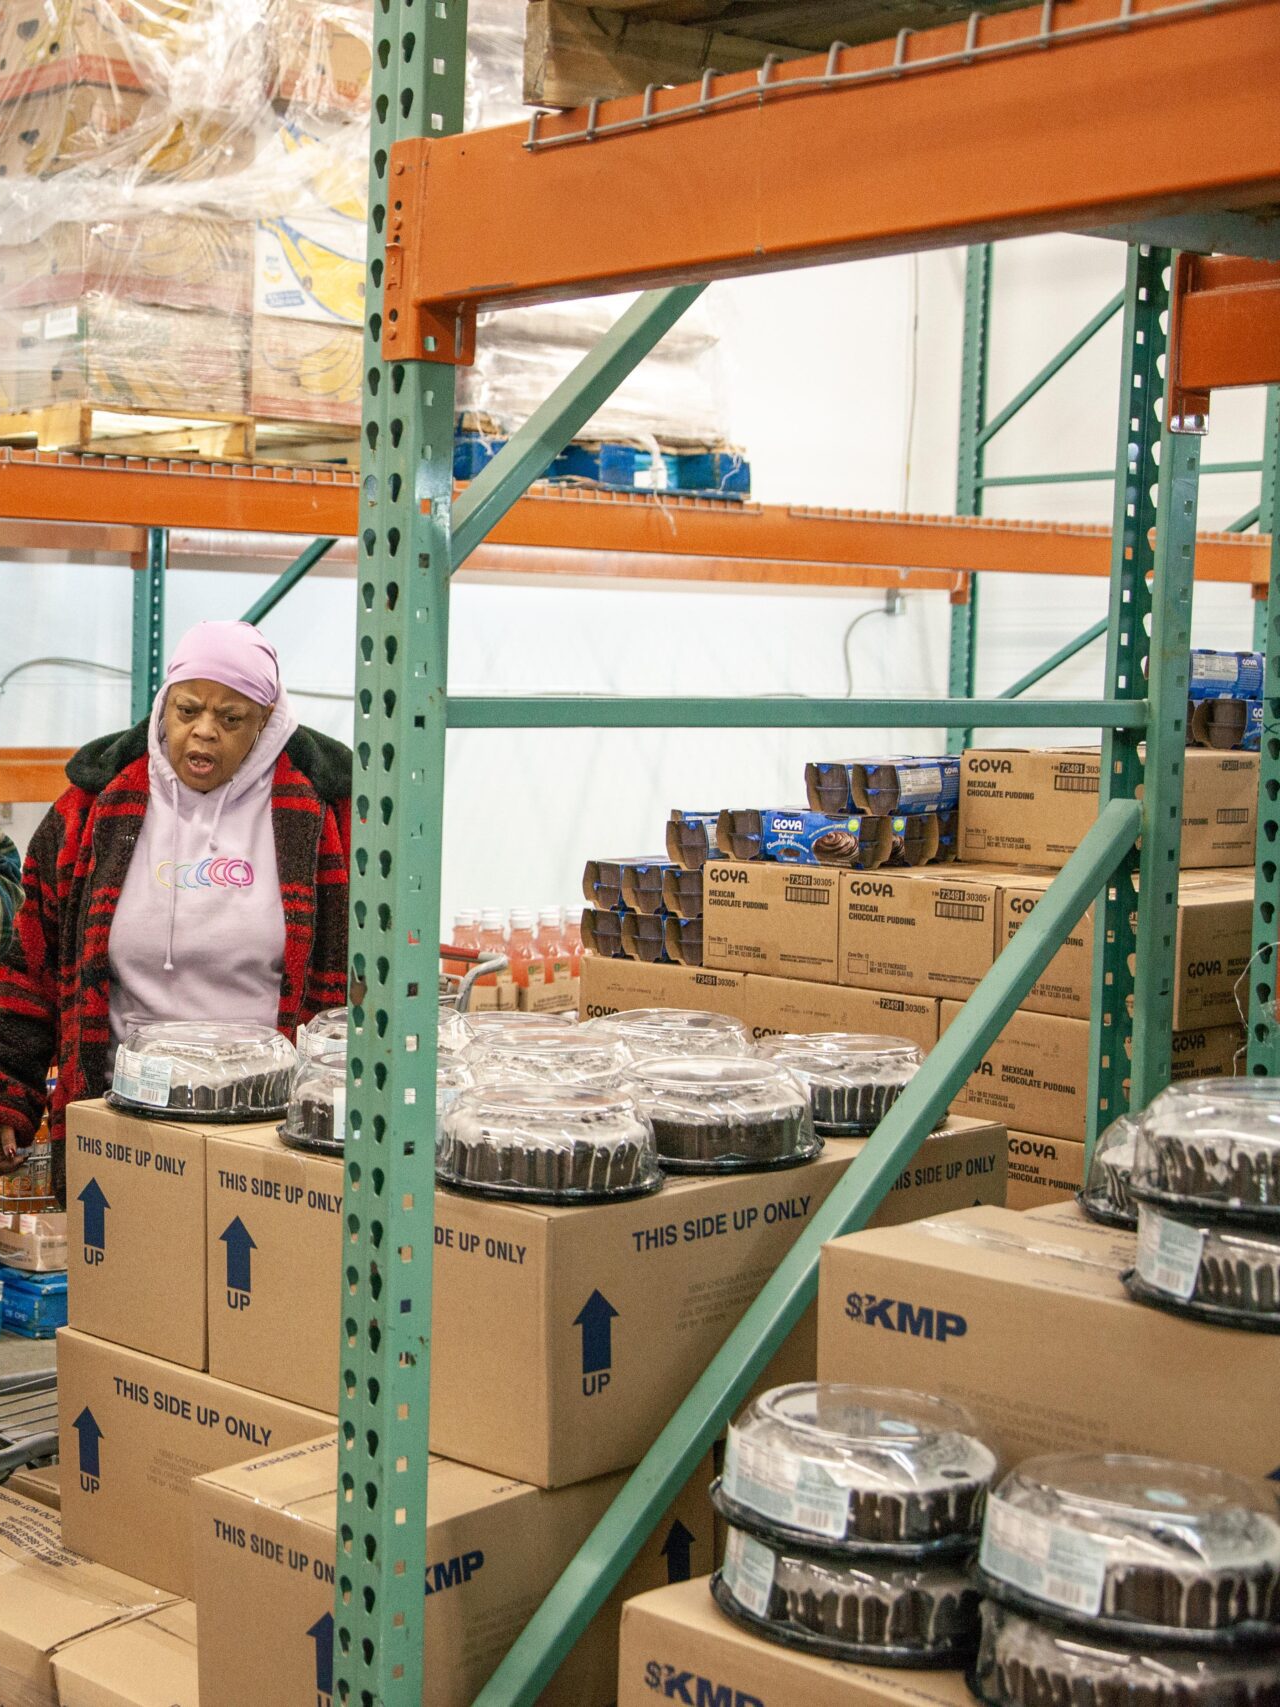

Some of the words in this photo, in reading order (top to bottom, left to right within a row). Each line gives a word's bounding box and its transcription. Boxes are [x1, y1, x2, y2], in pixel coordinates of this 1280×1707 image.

[1252, 707, 1263, 718] GO
[968, 759, 1012, 773] GOYA
[1060, 763, 1084, 773] 73491
[1086, 765, 1100, 774] 303
[967, 780, 997, 789] MEXICAN
[967, 789, 1004, 799] CHOCOLATE
[1005, 791, 1035, 800] PUDDING
[773, 819, 803, 831] GOYA
[710, 868, 748, 884] GOYA
[790, 874, 812, 886] 73491
[813, 878, 832, 887] 30305
[709, 889, 735, 898] MEXICAN
[850, 881, 893, 897] GOYA
[940, 889, 965, 900] 73491
[966, 892, 987, 903] 30305
[709, 898, 741, 908] CHOCOLATE
[743, 901, 768, 910] PUDDING
[849, 903, 878, 913] MEXICAN
[849, 912, 885, 923] CHOCOLATE
[887, 915, 916, 926] PUDDING
[1065, 937, 1084, 947] DING
[1187, 960, 1222, 979] GOYA
[696, 974, 716, 985] 73491
[880, 998, 904, 1011] 73491
[905, 1003, 926, 1014] 30305
[1172, 1034, 1206, 1053] GOYA
[1001, 1064, 1034, 1077] MEXICAN
[1001, 1075, 1041, 1089] CHOCOLATE
[1043, 1081, 1076, 1095] PUDDING
[76, 1135, 104, 1157] THIS
[107, 1142, 134, 1162] SIDE
[137, 1150, 153, 1168] UP
[156, 1154, 186, 1177] ONLY
[1008, 1138, 1056, 1161] GOYA
[891, 1171, 912, 1192] HIS
[915, 1165, 942, 1186] SIDE
[946, 1161, 962, 1180] UP
[965, 1155, 996, 1176] ONLY
[1008, 1161, 1039, 1175] MEXICAN
[1008, 1171, 1047, 1186] CHOCOLATE
[1048, 1178, 1081, 1192] PUDDING
[217, 1170, 248, 1192] THIS
[250, 1177, 282, 1201] SIDE
[285, 1185, 304, 1206] UP
[307, 1193, 343, 1215] ONLY
[632, 1224, 678, 1252] THIS
[683, 1213, 727, 1242] SIDE
[733, 1207, 758, 1231] UP
[763, 1195, 811, 1224] ONLY
[434, 1226, 453, 1248] DE
[457, 1231, 481, 1254] UP
[484, 1236, 526, 1265] ONLY
[83, 1247, 105, 1267] UP
[226, 1290, 251, 1311] UP
[583, 1373, 611, 1397] UP
[113, 1378, 149, 1405] THIS
[153, 1390, 191, 1421] SIDE
[196, 1405, 220, 1430] UP
[224, 1416, 272, 1448] ONLY
[80, 1474, 101, 1494] UP
[21, 1504, 41, 1515] NOT
[213, 1519, 246, 1545] THIS
[250, 1530, 283, 1558] SIDE
[287, 1542, 309, 1568] UP
[313, 1553, 334, 1584] ON
